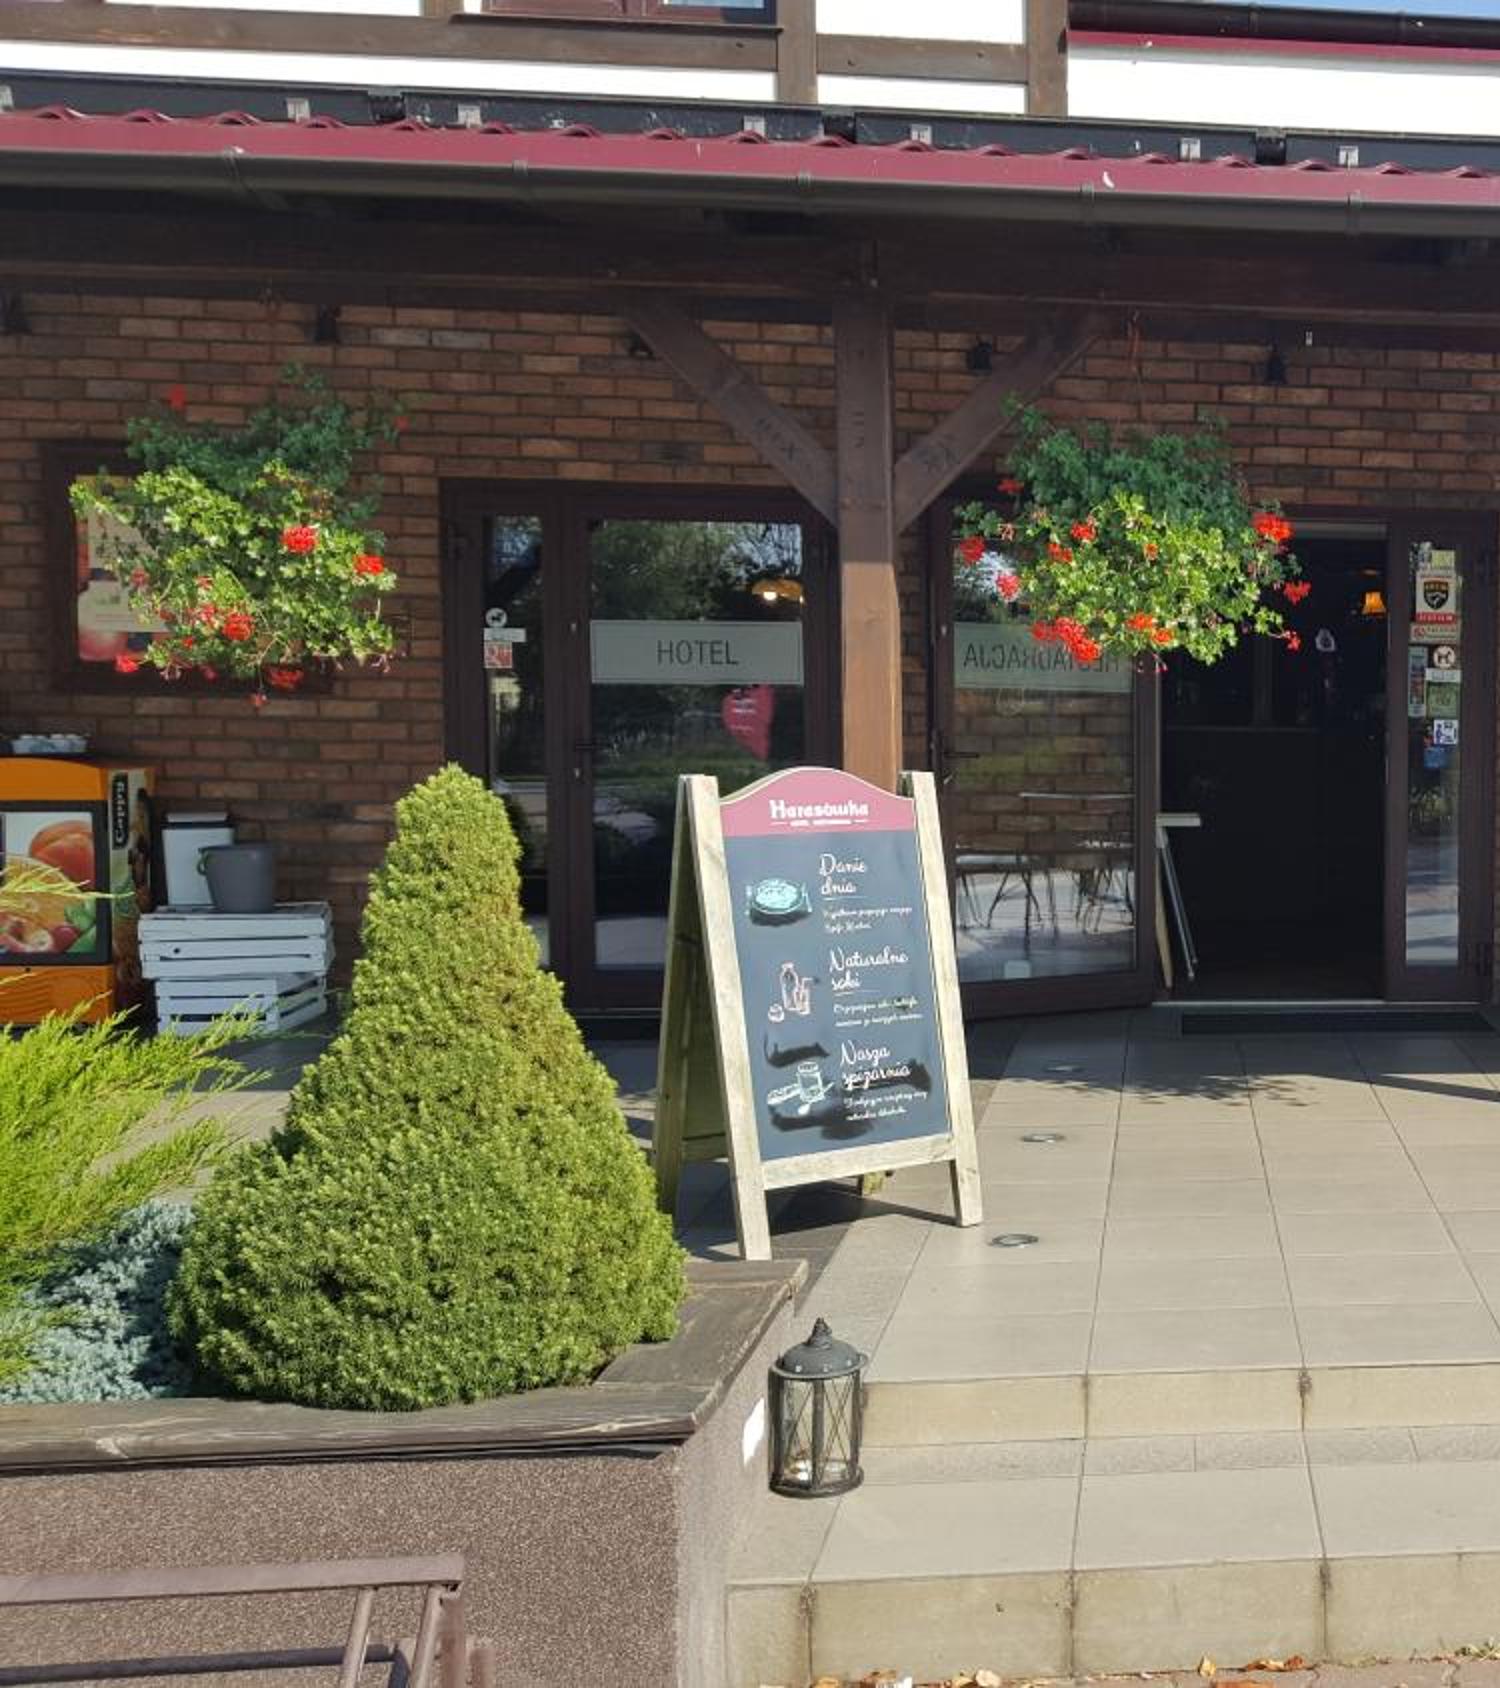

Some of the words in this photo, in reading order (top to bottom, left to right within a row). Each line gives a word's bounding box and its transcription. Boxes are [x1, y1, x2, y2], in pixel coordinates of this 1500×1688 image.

[657, 639, 739, 665] HOTEL
[818, 853, 868, 876] Danie
[820, 876, 857, 896] dnia
[829, 945, 910, 973] Naturalne
[831, 970, 861, 991] soki
[840, 1039, 891, 1067] Nasza
